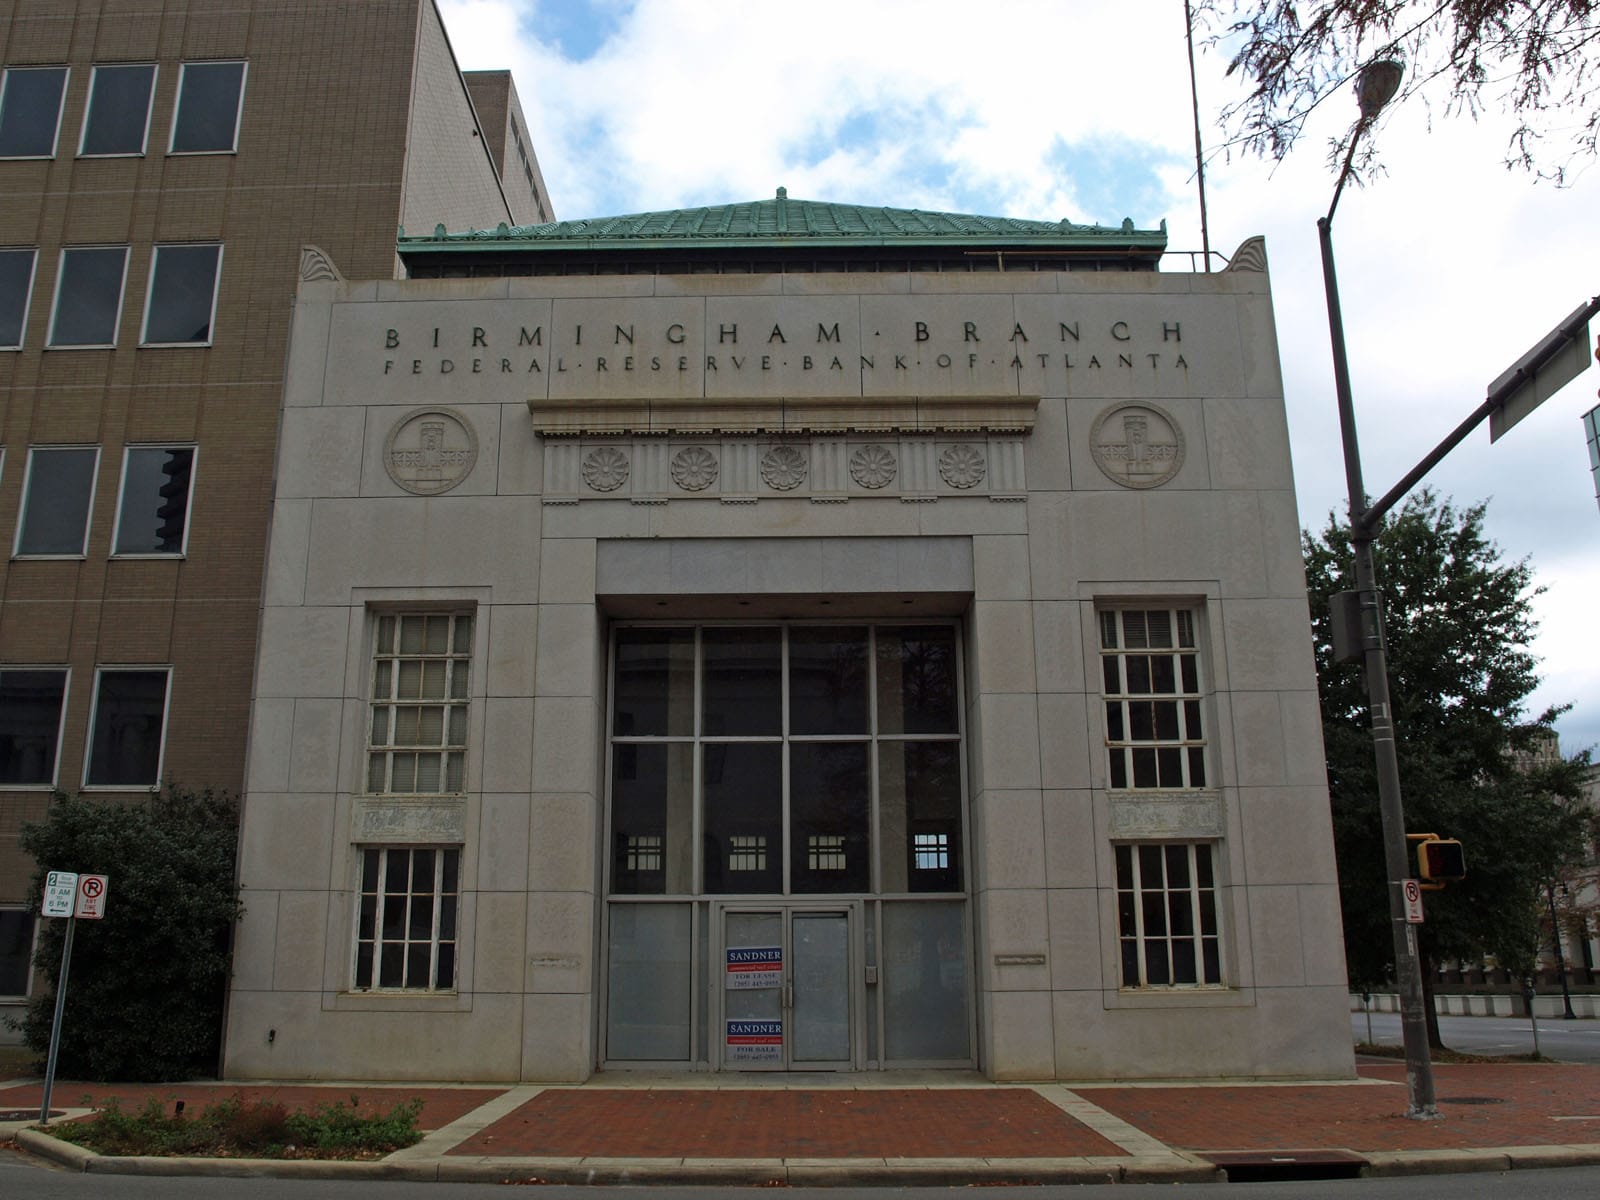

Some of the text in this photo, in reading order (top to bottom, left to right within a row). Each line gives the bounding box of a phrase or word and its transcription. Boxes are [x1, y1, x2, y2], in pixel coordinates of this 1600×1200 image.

[385, 321, 1182, 349] BIRMINGHAM BRANCH
[383, 353, 1189, 375] FEDERAL RESERVE BANK OF ATLANTA
[50, 874, 56, 885] 2
[730, 951, 781, 961] SANDNER
[730, 1024, 782, 1033] SANDNER
